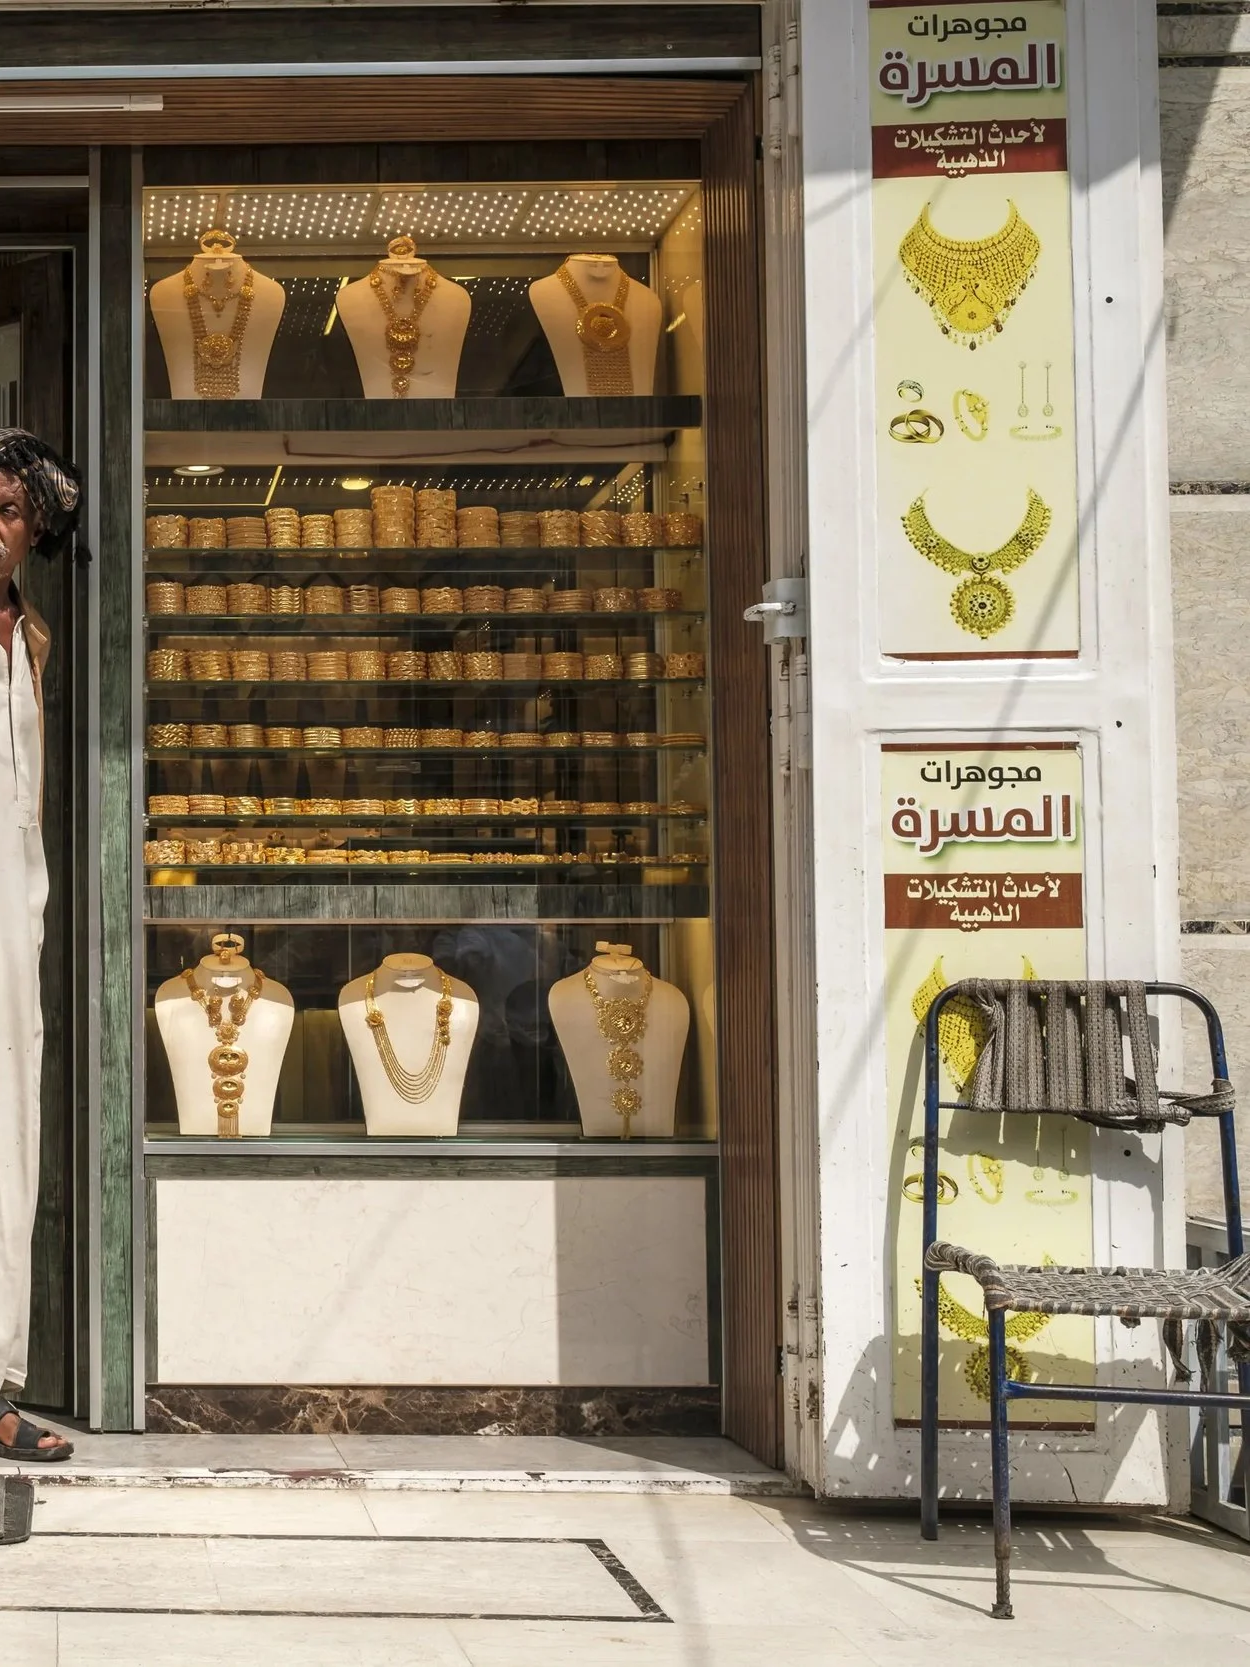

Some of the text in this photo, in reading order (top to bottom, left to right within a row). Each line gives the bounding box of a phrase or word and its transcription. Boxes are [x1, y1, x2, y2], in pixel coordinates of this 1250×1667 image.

[907, 14, 1027, 42] مجوهرات
[879, 43, 1056, 103] المسرة
[893, 121, 1046, 153] لأحدث التشكيلات
[936, 148, 1006, 175] الذهبية
[920, 760, 1042, 789] مجوهرات
[891, 795, 1072, 853] المسرة
[906, 874, 1062, 905] لأحدث التشكيلات
[949, 901, 1021, 929] الذهبية
